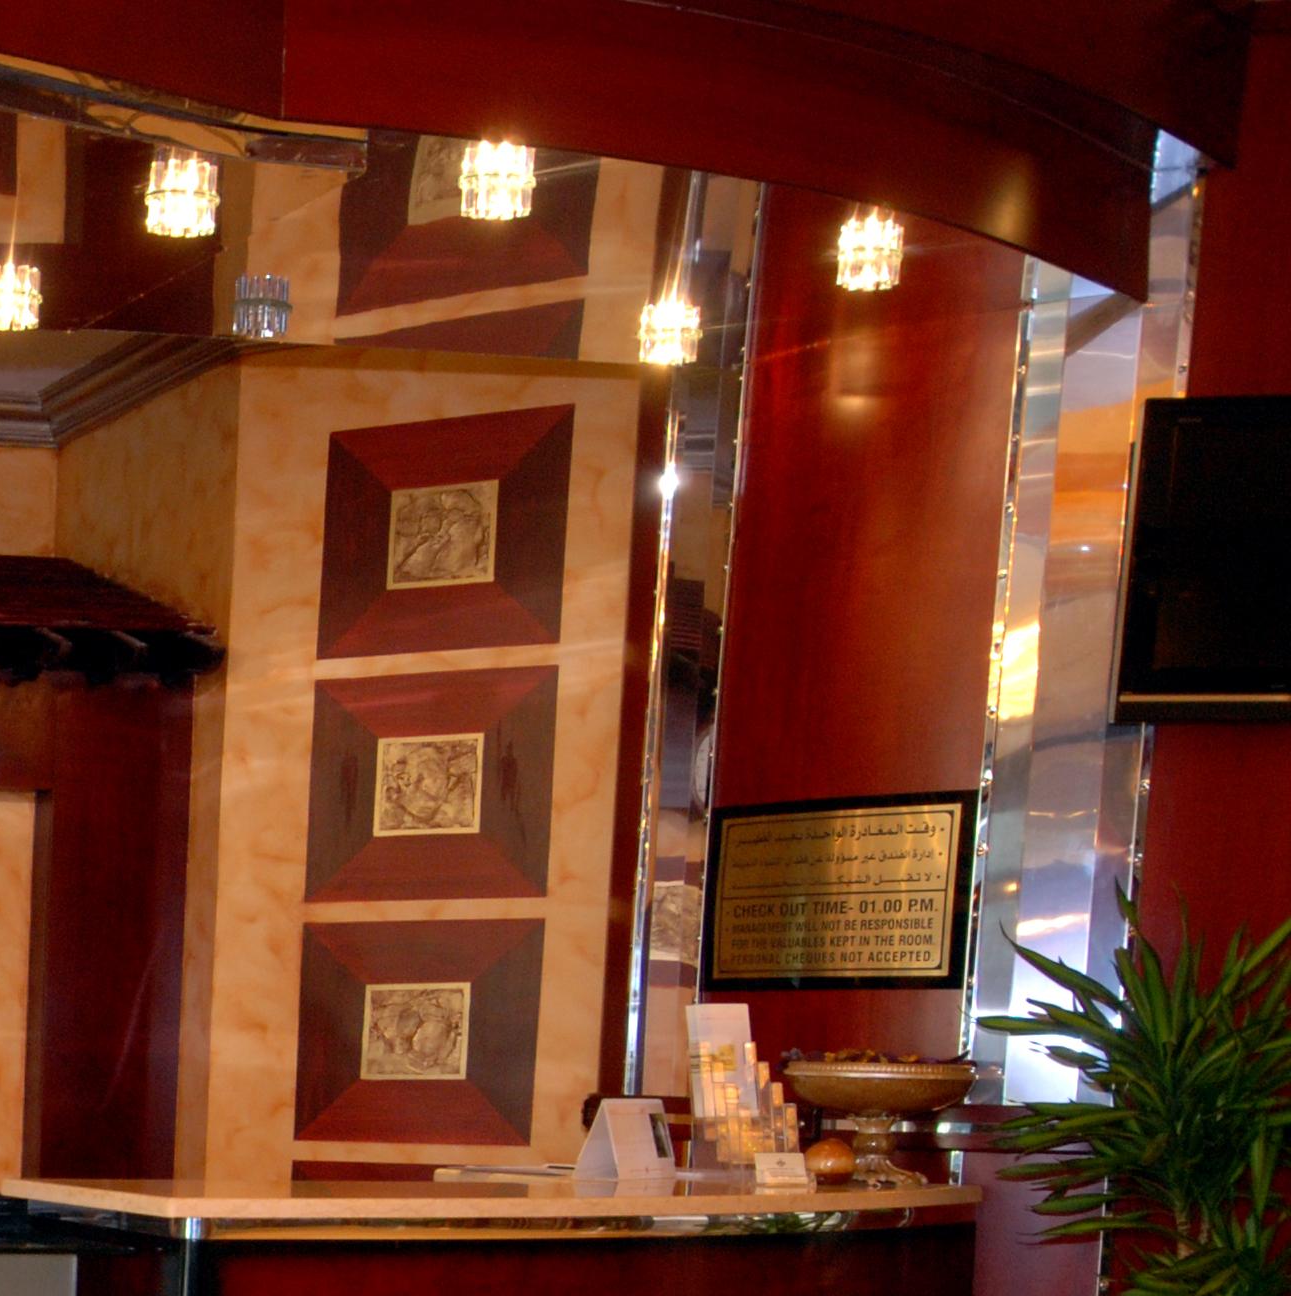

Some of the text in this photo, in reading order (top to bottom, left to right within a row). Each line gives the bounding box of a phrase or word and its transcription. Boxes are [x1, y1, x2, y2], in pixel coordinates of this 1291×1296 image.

[733, 904, 775, 918] CHECK
[779, 902, 807, 917] OUT
[859, 900, 902, 913] 01.00
[908, 899, 938, 912] P.M.
[795, 920, 818, 932] WILL
[820, 919, 840, 931] NOT
[844, 919, 857, 930] BE
[860, 918, 933, 931] RESPONSIBLE
[769, 936, 826, 949] VALUABLES
[829, 935, 856, 947] KEPT
[859, 935, 870, 946] IN
[875, 935, 895, 946] THE
[785, 951, 835, 964] CHEQUES
[840, 951, 864, 962] NOT
